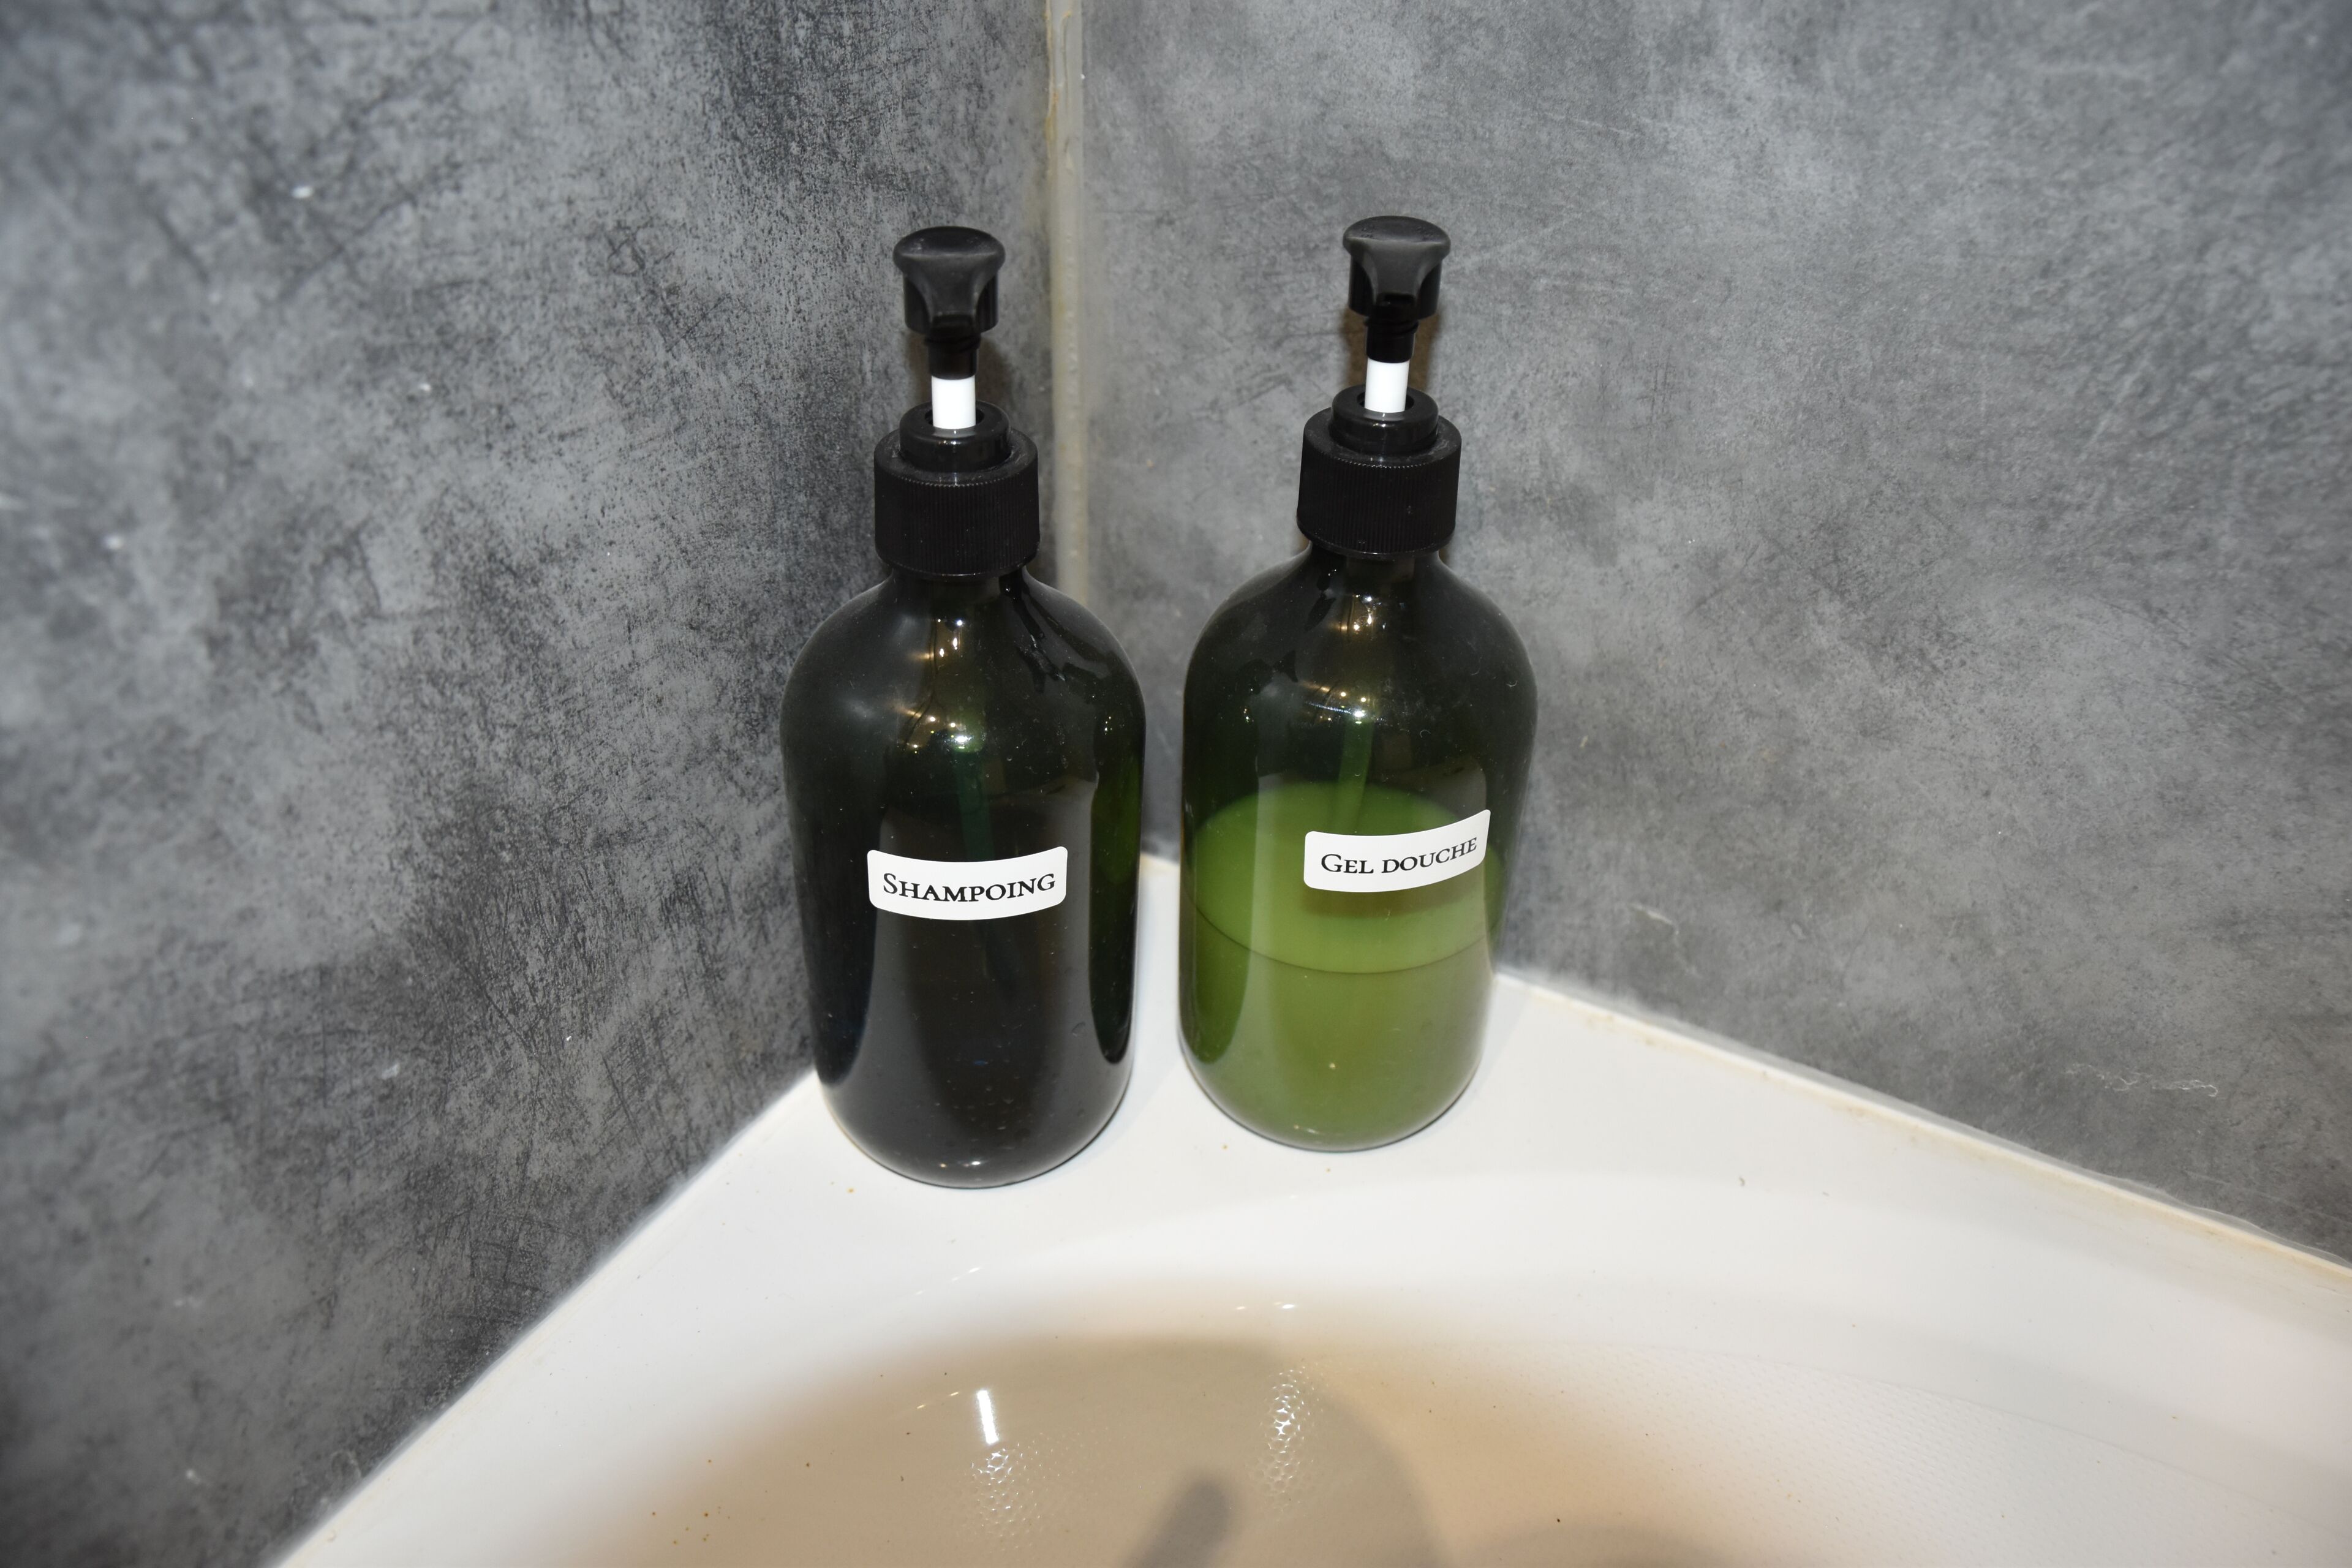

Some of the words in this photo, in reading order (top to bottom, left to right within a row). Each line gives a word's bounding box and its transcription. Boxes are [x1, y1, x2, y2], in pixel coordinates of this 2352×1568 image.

[1321, 853, 1374, 874] GEL
[1381, 837, 1477, 874] DOUCHE
[883, 873, 1055, 902] SHAMPOING
